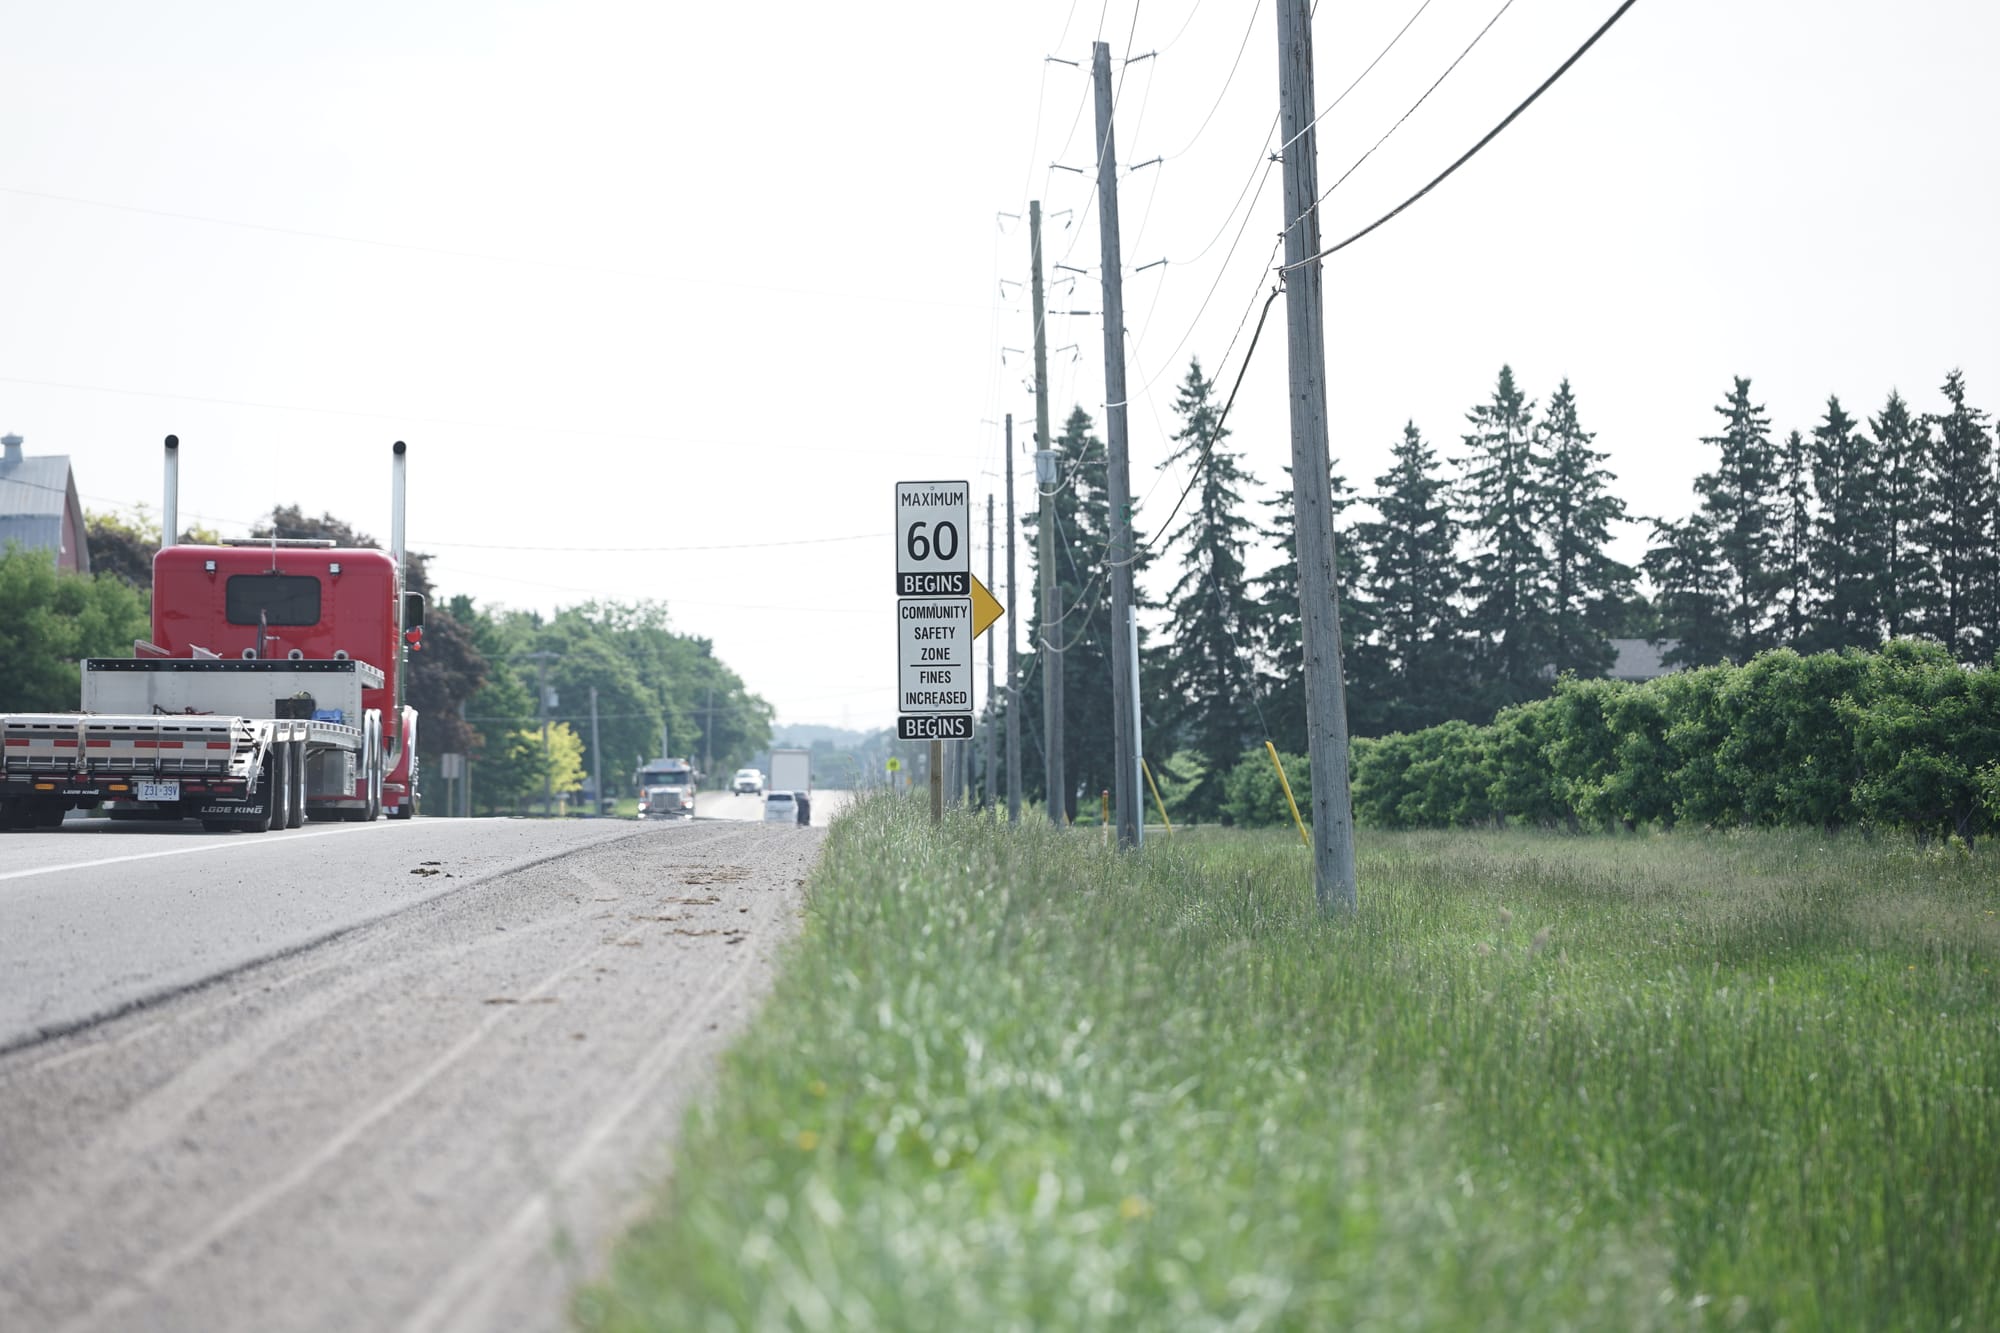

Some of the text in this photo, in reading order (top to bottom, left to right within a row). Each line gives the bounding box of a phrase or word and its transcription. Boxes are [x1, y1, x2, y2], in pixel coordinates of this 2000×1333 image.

[901, 492, 964, 507] MAXIMUM
[907, 521, 959, 561] 60
[904, 574, 963, 593] BEGINS
[902, 605, 968, 620] COMMUNITY
[914, 626, 956, 640] SAFETY
[921, 647, 951, 661] ZONE
[920, 670, 952, 684] FINES
[905, 691, 967, 705] INCREASED
[906, 718, 965, 737] BEGINS
[234, 805, 264, 814] KING
